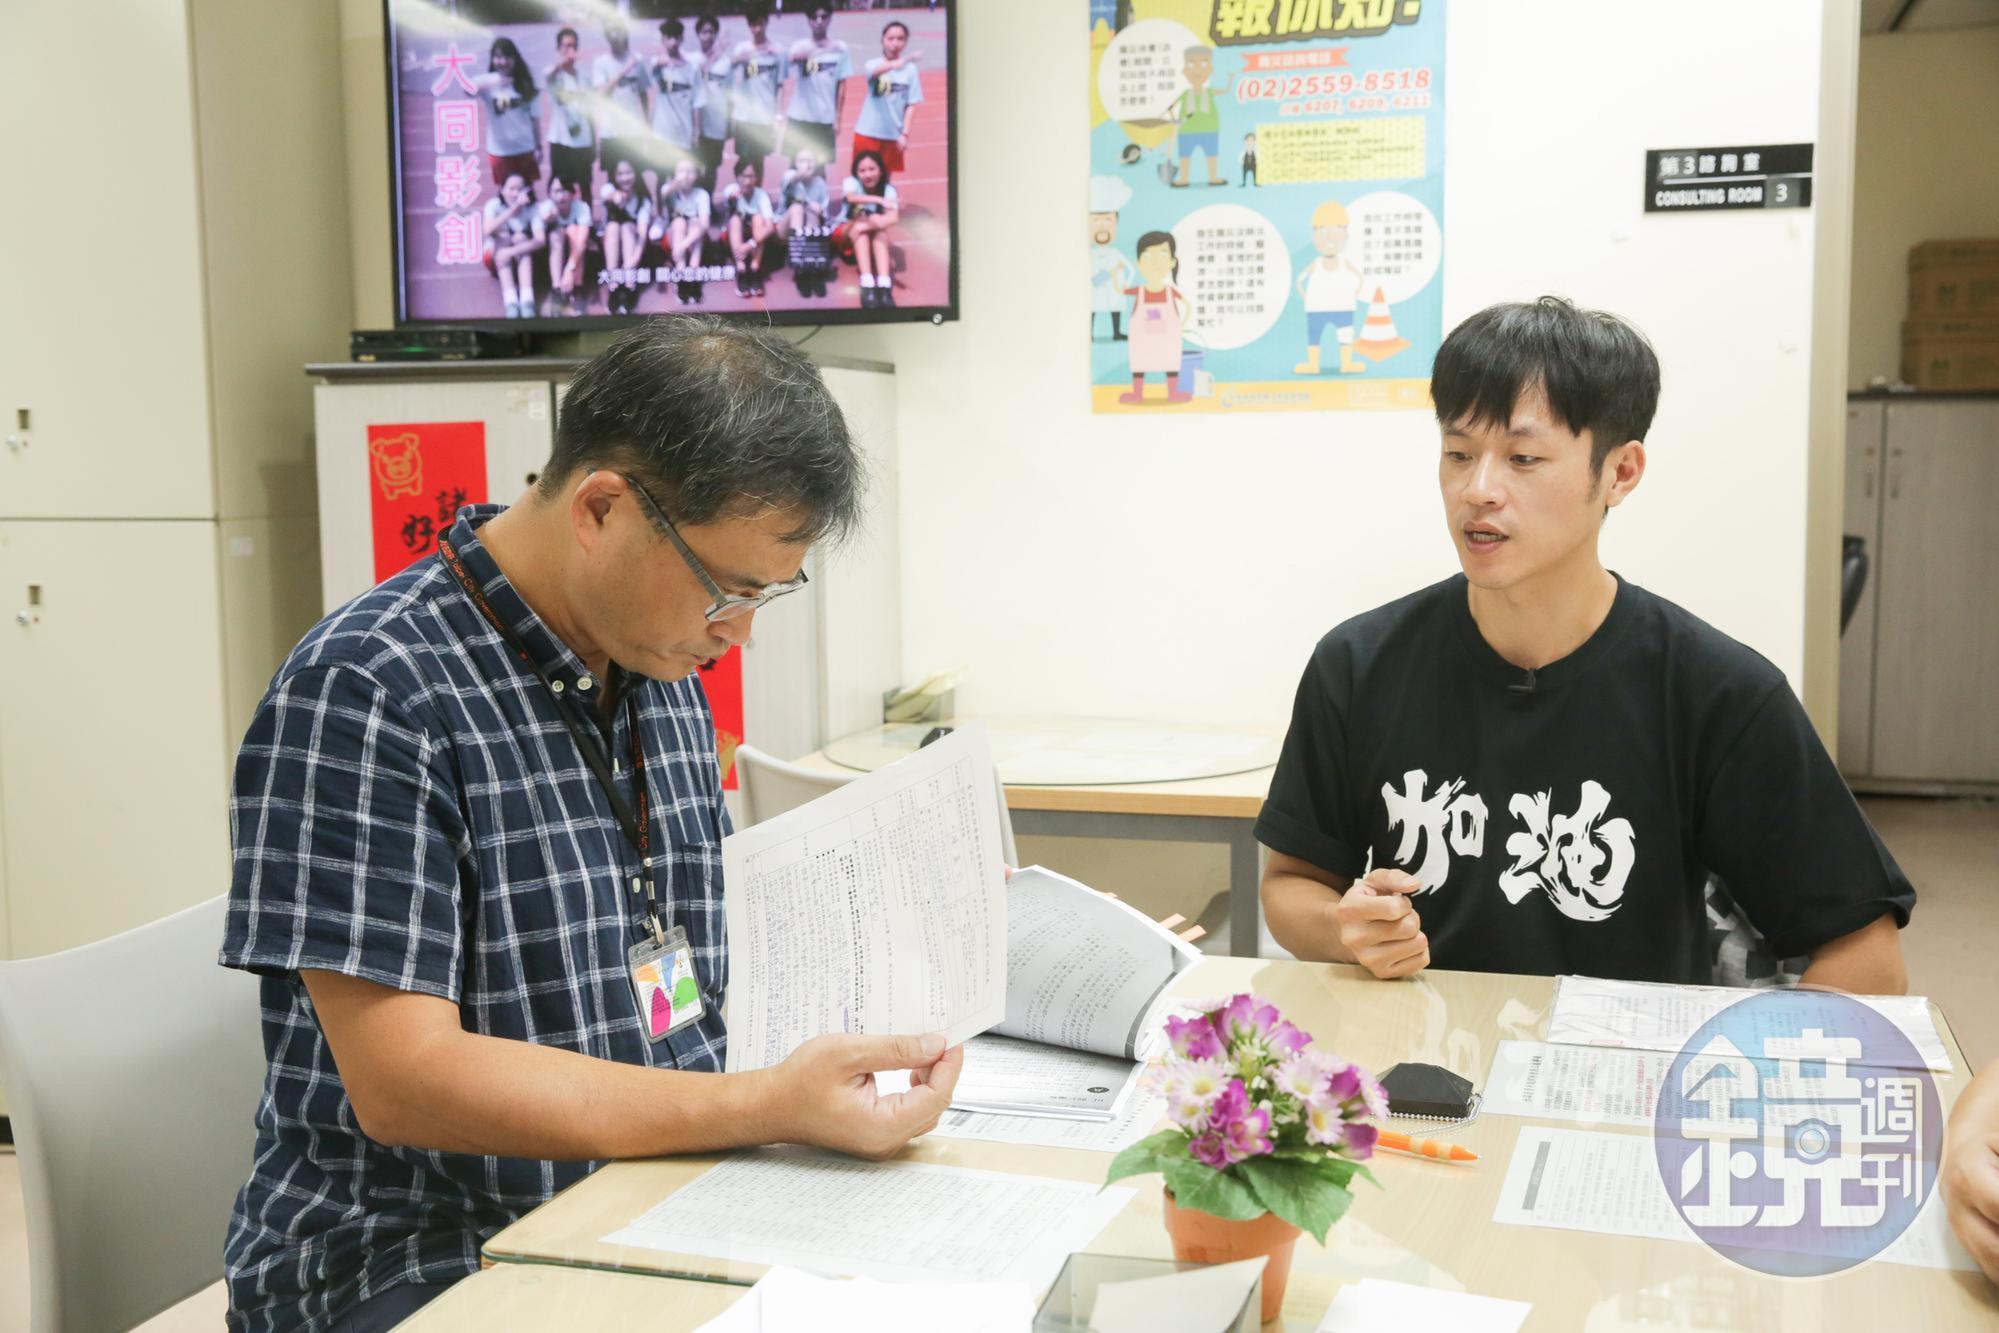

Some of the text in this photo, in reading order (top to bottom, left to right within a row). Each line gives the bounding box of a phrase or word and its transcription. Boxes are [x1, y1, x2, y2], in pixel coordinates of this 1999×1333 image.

[1238, 69, 1430, 101] (02)2559-8518
[431, 43, 483, 267] 大同影創
[1655, 183, 1788, 206] CONSULTING ROOM 3
